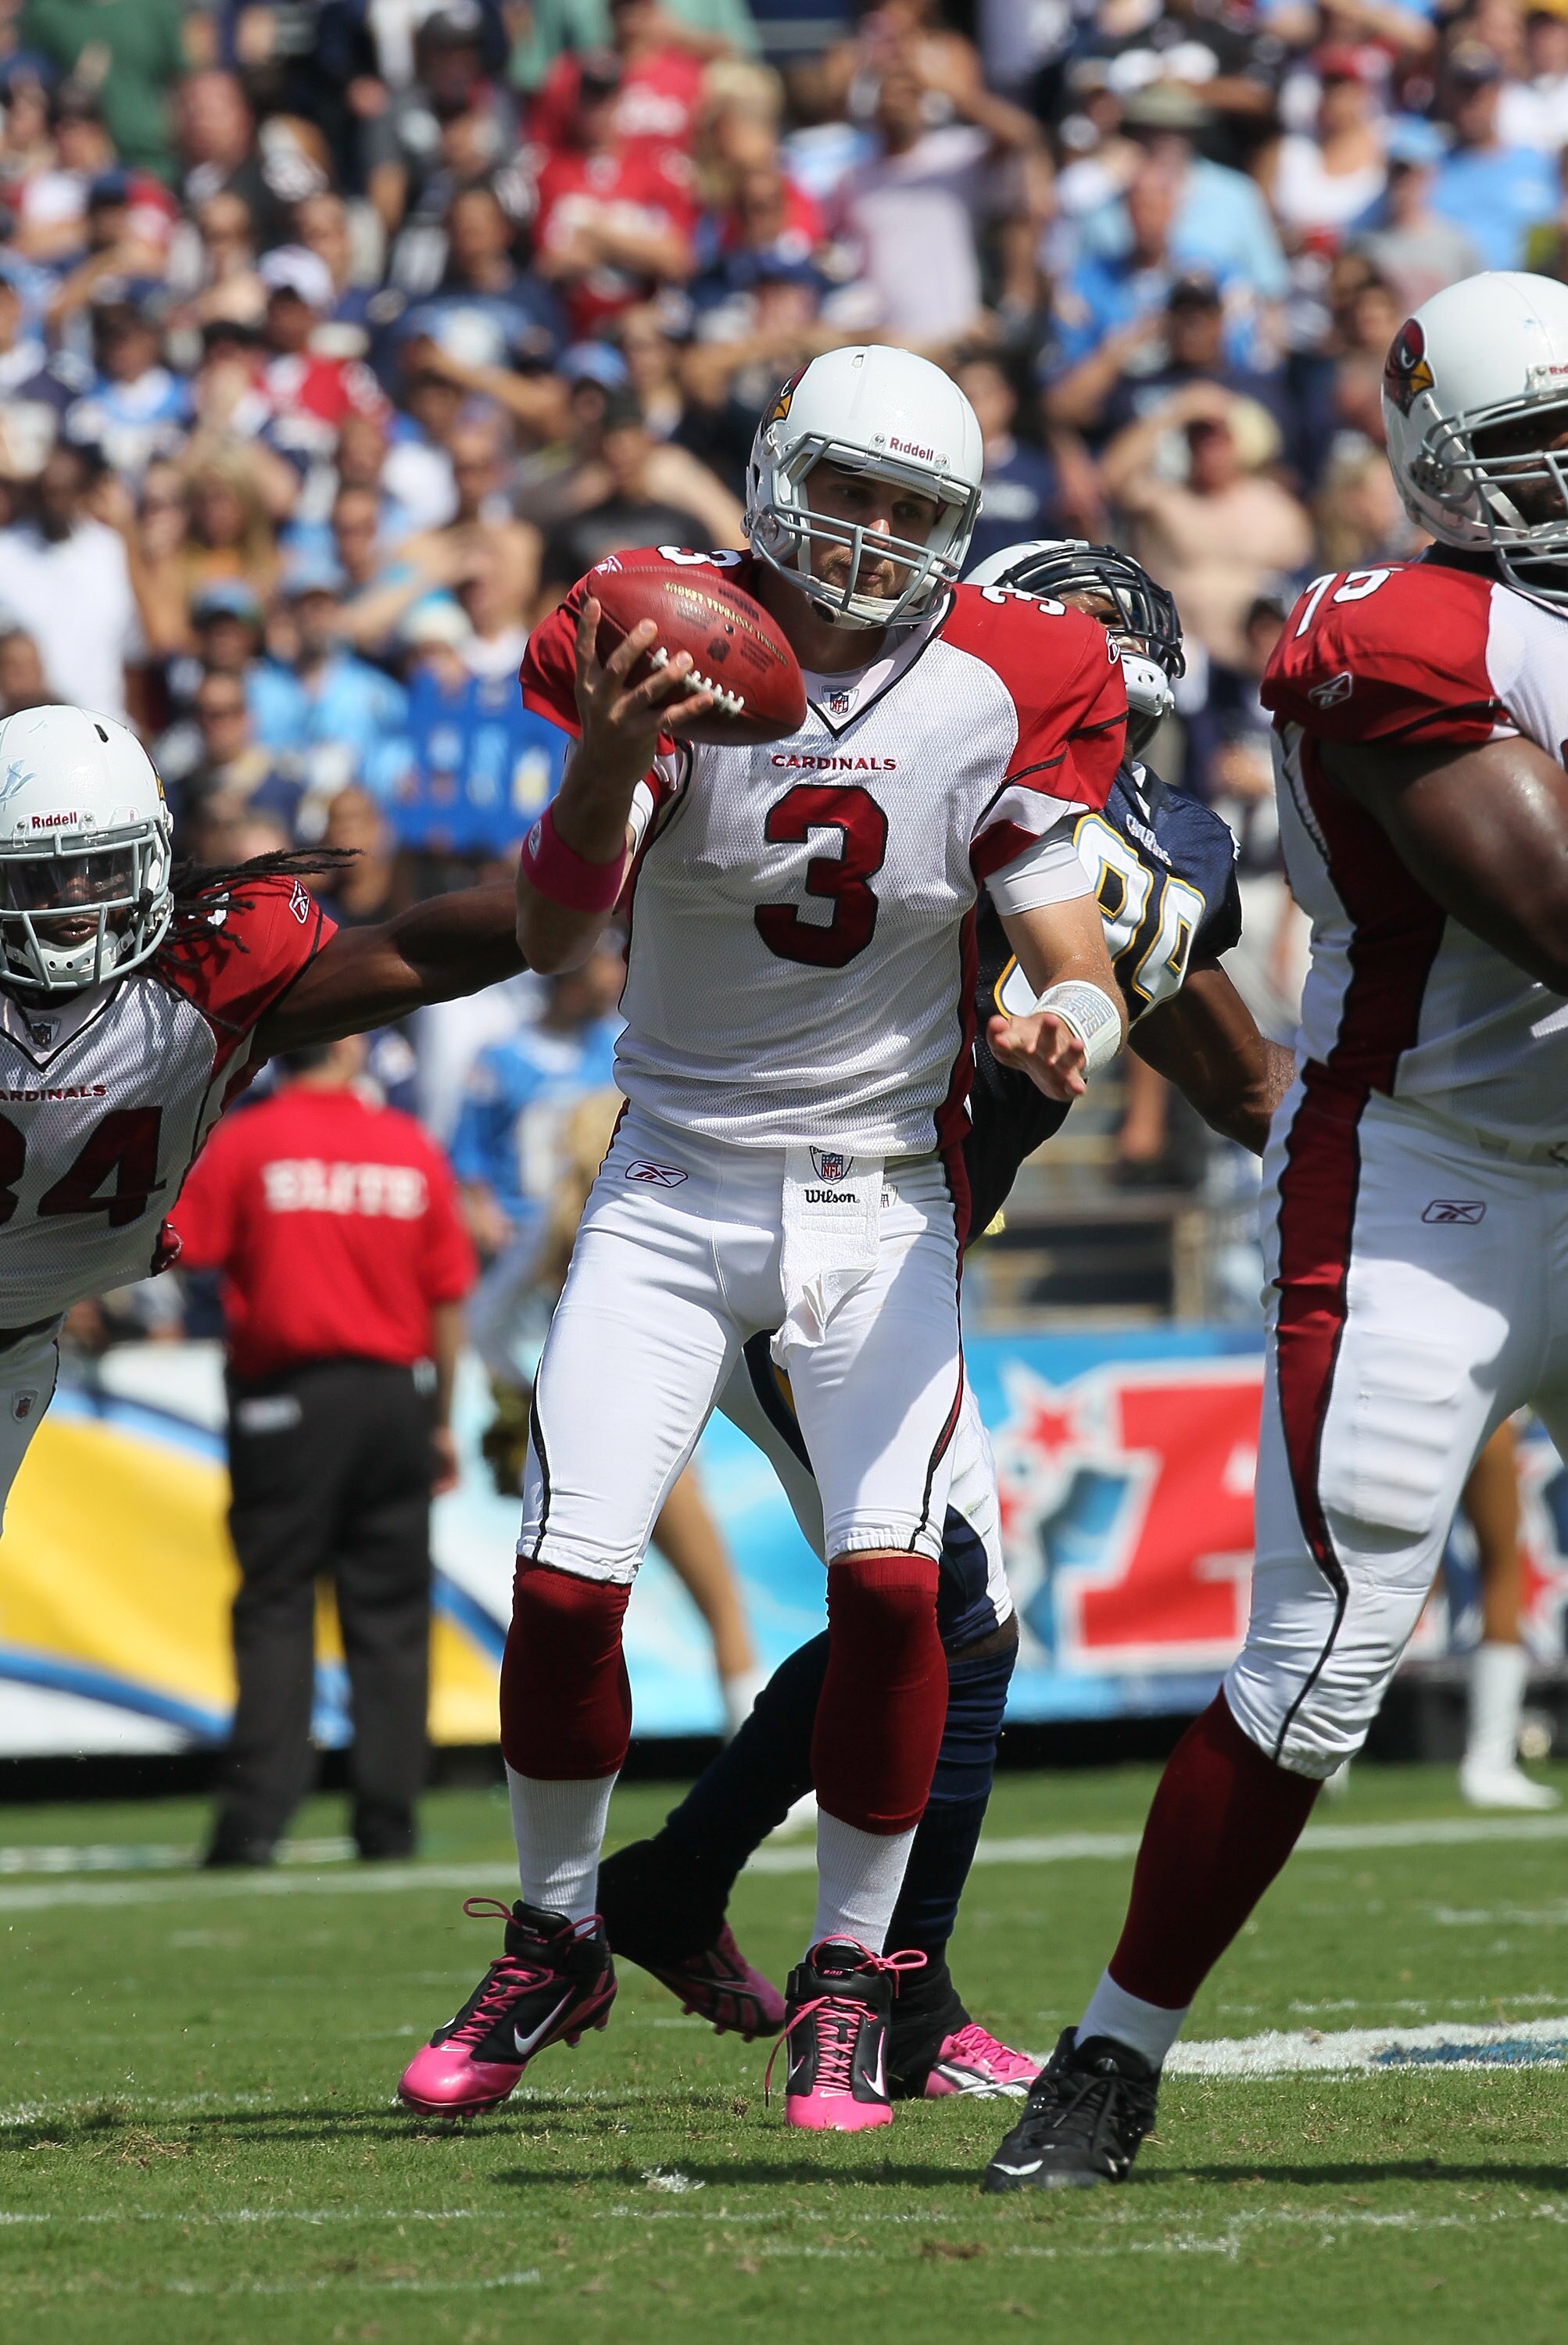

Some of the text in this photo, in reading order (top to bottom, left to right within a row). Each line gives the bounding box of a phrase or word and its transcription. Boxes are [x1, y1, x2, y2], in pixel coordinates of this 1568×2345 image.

[890, 436, 934, 462] Riddell
[771, 754, 897, 771] CARDINALS
[31, 811, 77, 829] Riddell
[754, 783, 889, 968] 3
[0, 1085, 107, 1102] ARDINALS
[0, 1105, 166, 1227] 4
[822, 1163, 842, 1179] NFL
[804, 1189, 856, 1204] Wilson
